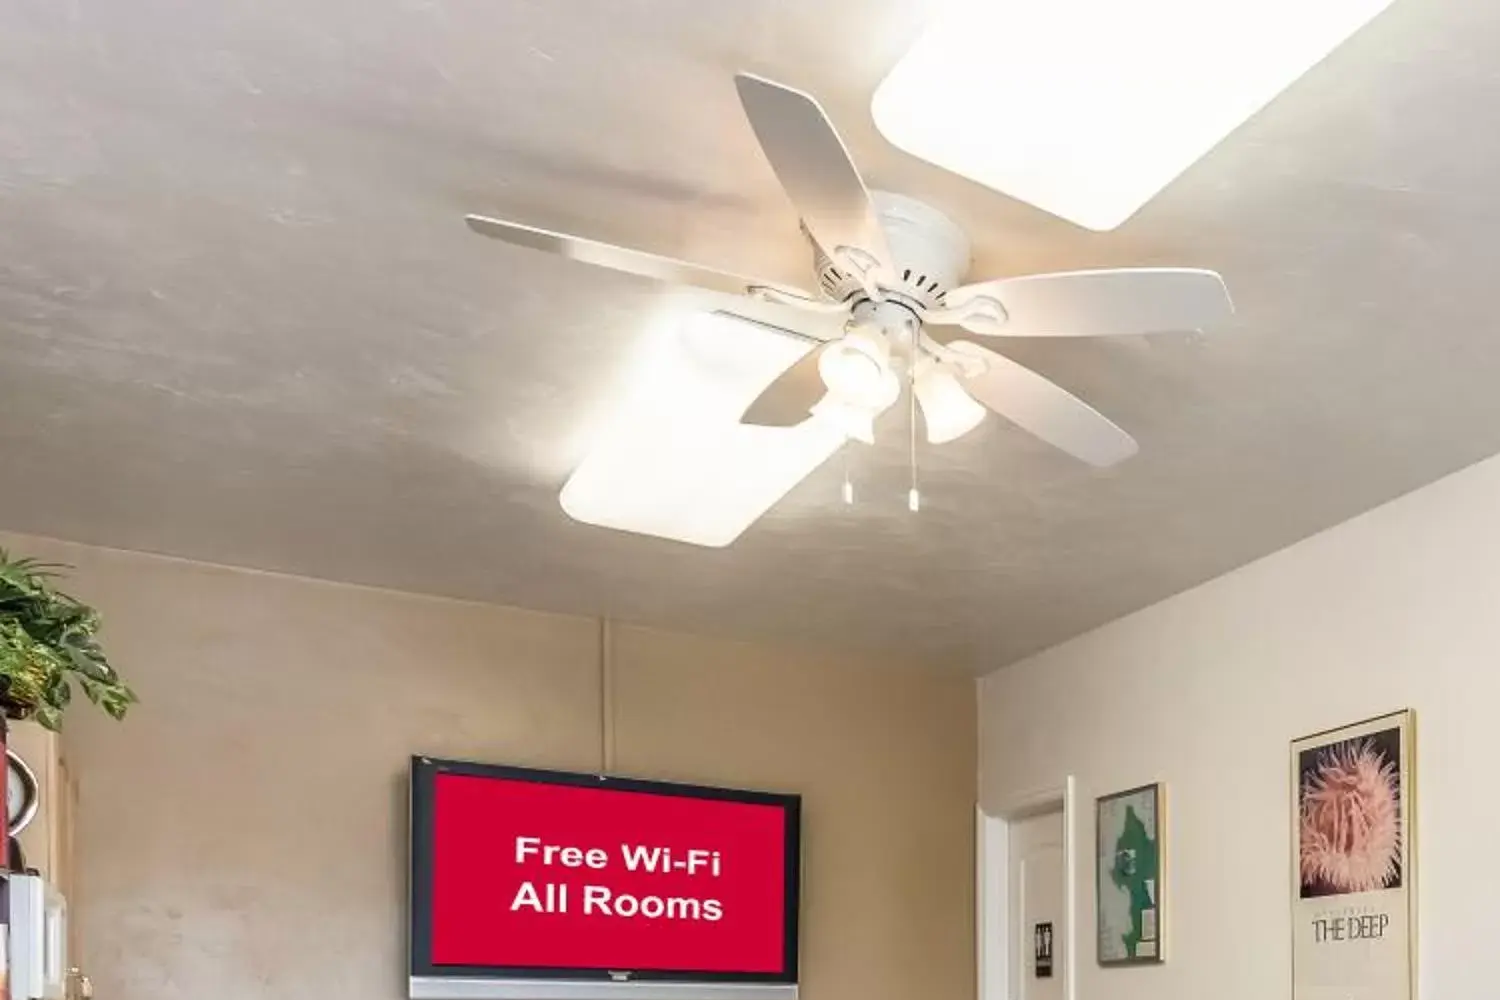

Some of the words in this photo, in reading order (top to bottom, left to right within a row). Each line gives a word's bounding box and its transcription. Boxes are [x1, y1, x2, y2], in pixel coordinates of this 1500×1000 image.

[515, 837, 608, 869] Free
[621, 844, 720, 877] Wi-Fi
[510, 882, 567, 913] All
[583, 885, 723, 921] Rooms
[1312, 917, 1344, 942] THE
[1348, 914, 1389, 939] DEEP
